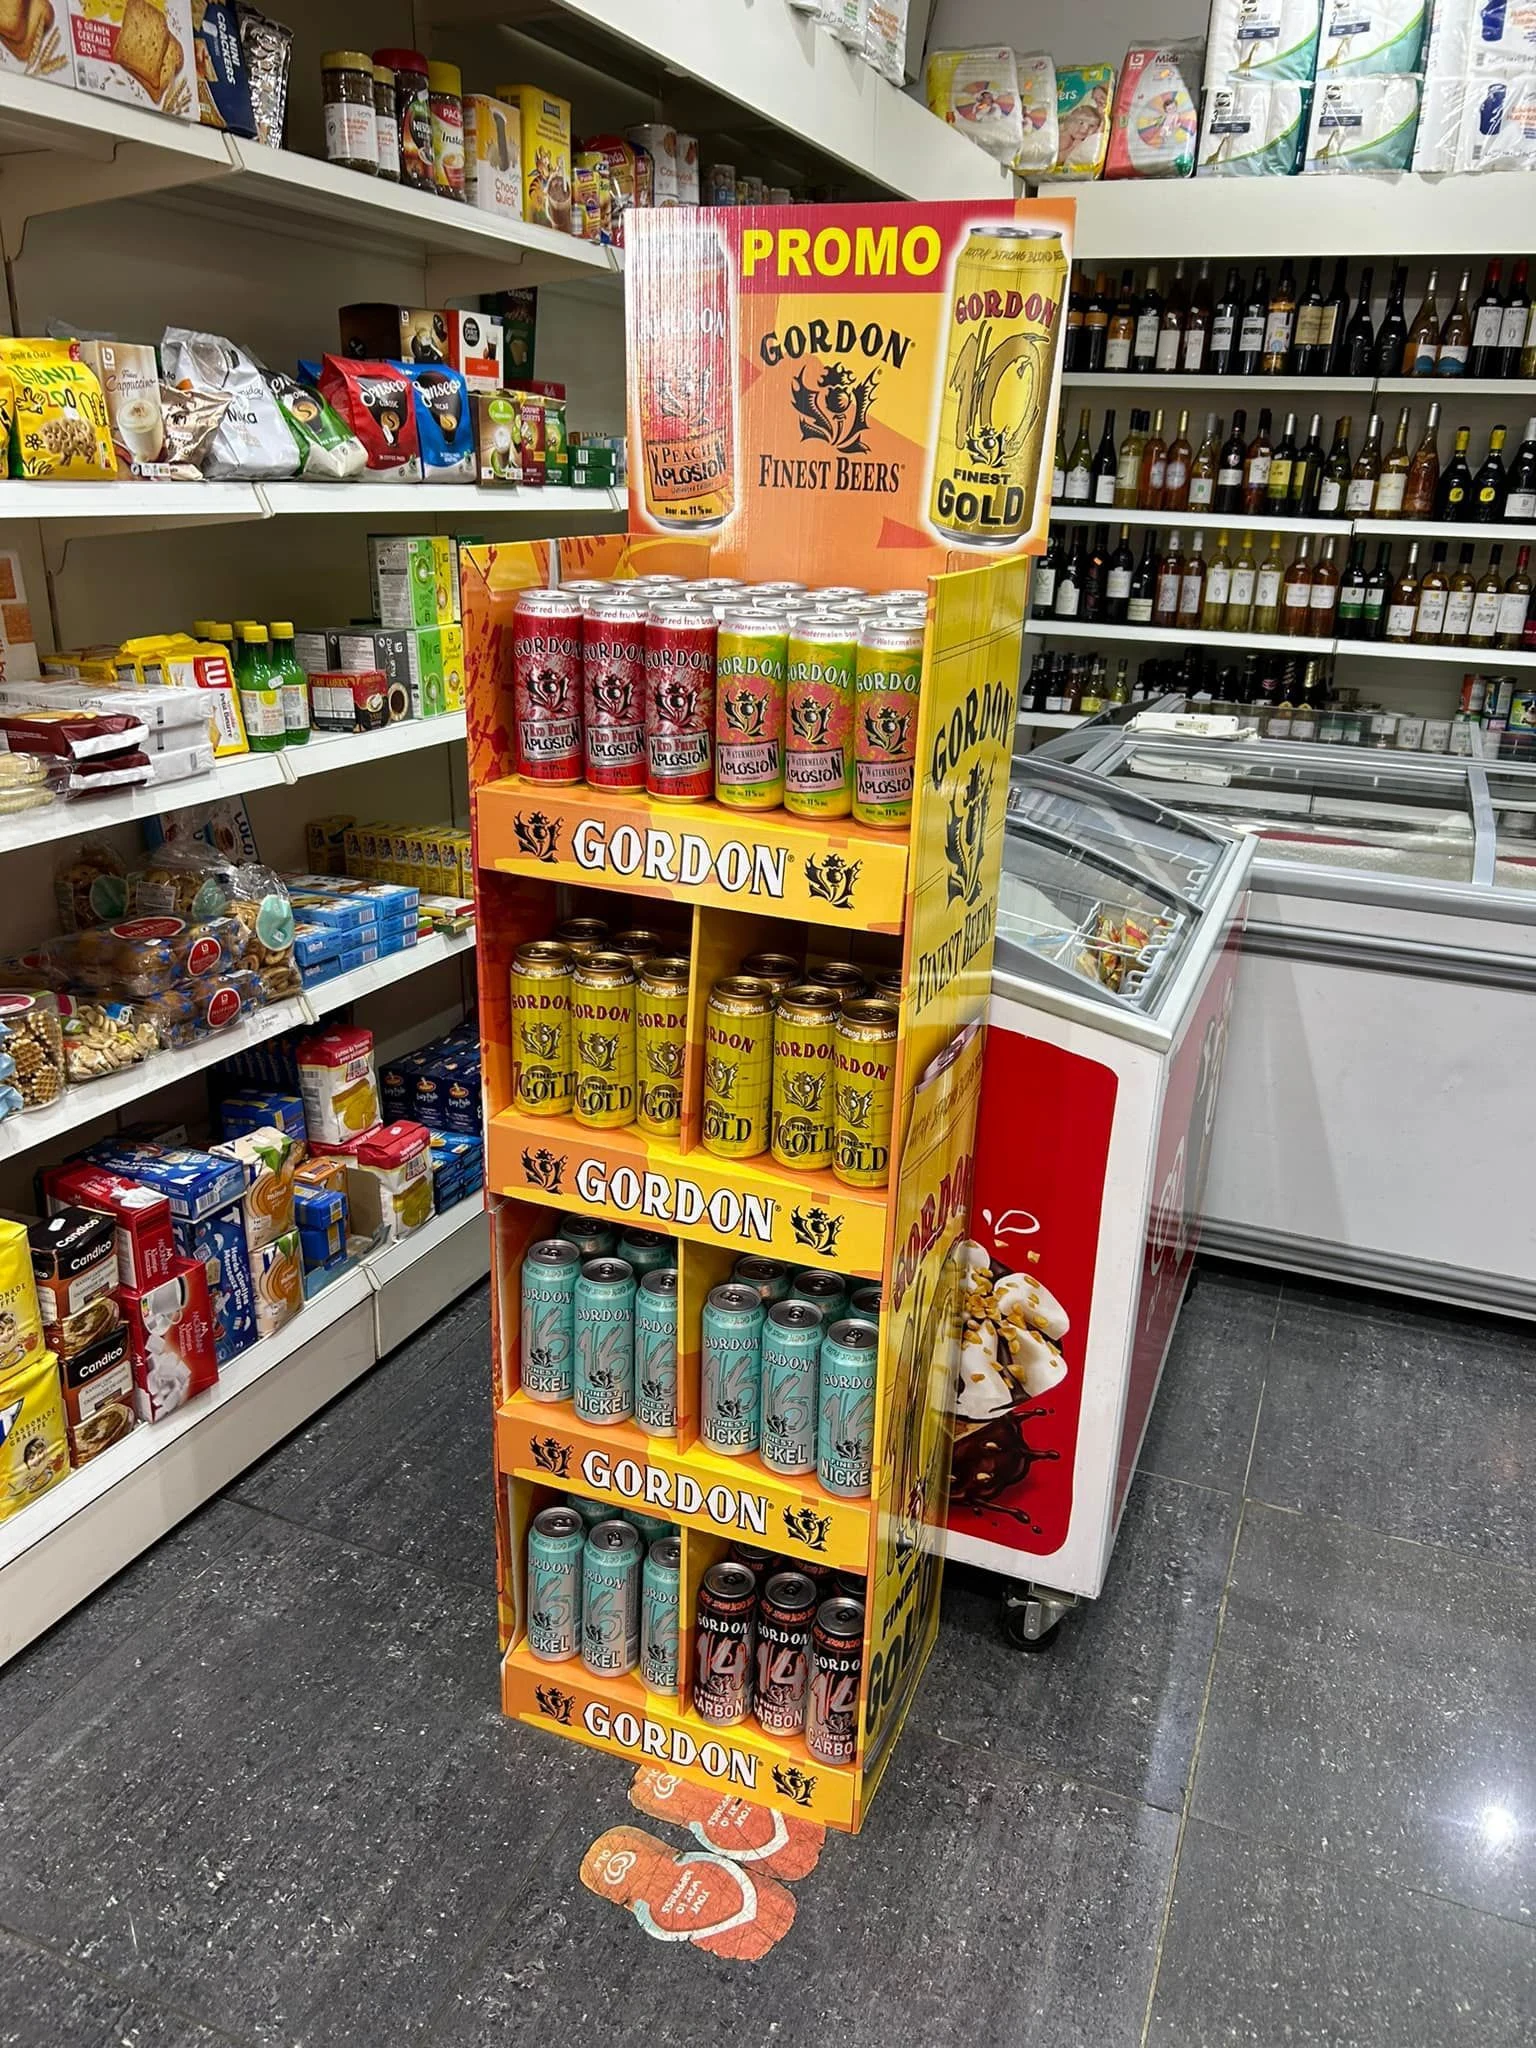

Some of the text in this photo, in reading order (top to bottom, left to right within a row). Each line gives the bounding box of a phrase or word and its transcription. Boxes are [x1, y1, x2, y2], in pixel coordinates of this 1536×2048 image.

[217, 12, 236, 84] CRACKERS
[230, 34, 240, 66] MINI
[742, 225, 942, 278] PROMO
[955, 290, 1056, 328] GORDON
[760, 318, 911, 368] GORDON
[7, 365, 86, 385] LEIBNIZ
[106, 376, 157, 396] Cappuccino
[650, 440, 726, 487] XPLOSION
[661, 444, 711, 464] PEACH
[758, 454, 900, 493] FINEST BEERS
[954, 468, 1010, 485] FINEST
[938, 478, 1025, 526] GOLD
[514, 636, 582, 660] GORDON
[204, 660, 227, 686] LU
[521, 722, 580, 752] XPLOSION
[588, 728, 645, 757] XPLOSION
[932, 681, 1012, 792] GORDON
[651, 737, 709, 767] XPLOSION
[719, 748, 778, 777] XPLOSION
[725, 749, 765, 758] WATERMELON
[790, 756, 829, 766] WATERMELON
[865, 767, 907, 777] WATERMELON
[572, 818, 788, 898] GORDON
[916, 896, 993, 1016] FINEST BEERS
[576, 1084, 632, 1113] GOLD
[791, 1124, 824, 1132] FINEST
[575, 1158, 776, 1242] GORDON
[56, 1218, 100, 1248] Candico
[70, 1240, 112, 1270] Candico
[224, 1249, 243, 1312] Morceaux Durs
[230, 1246, 250, 1306] Harde Klontjes
[79, 1347, 124, 1378] Candico
[576, 1324, 632, 1386] 16
[585, 1390, 618, 1398] FINEST
[704, 1352, 759, 1413] 16
[824, 1372, 874, 1389] GORDO
[576, 1388, 630, 1415] NICKEL
[8, 1407, 56, 1440] CASSONADE
[10, 1422, 46, 1448] GRAEFFE
[704, 1418, 758, 1446] NICKEL
[712, 1418, 747, 1428] FINEST
[820, 1458, 871, 1486] NICKE
[830, 1459, 867, 1469] FINEST
[580, 1450, 768, 1535] GORDON
[697, 1613, 750, 1634] GORDON
[757, 1622, 809, 1646] GORDON
[696, 1633, 748, 1690] 14
[757, 1641, 808, 1700] 14
[813, 1652, 860, 1671] GORDO
[694, 1686, 744, 1716] CARBON
[700, 1690, 731, 1704] FINEST
[760, 1699, 791, 1712] FINEST
[810, 1671, 858, 1725] 14
[754, 1696, 804, 1728] CARBON
[583, 1702, 758, 1788] GORDON
[808, 1727, 854, 1755] CARBO
[819, 1732, 852, 1742] FINEST
[594, 1849, 612, 1871] OLA
